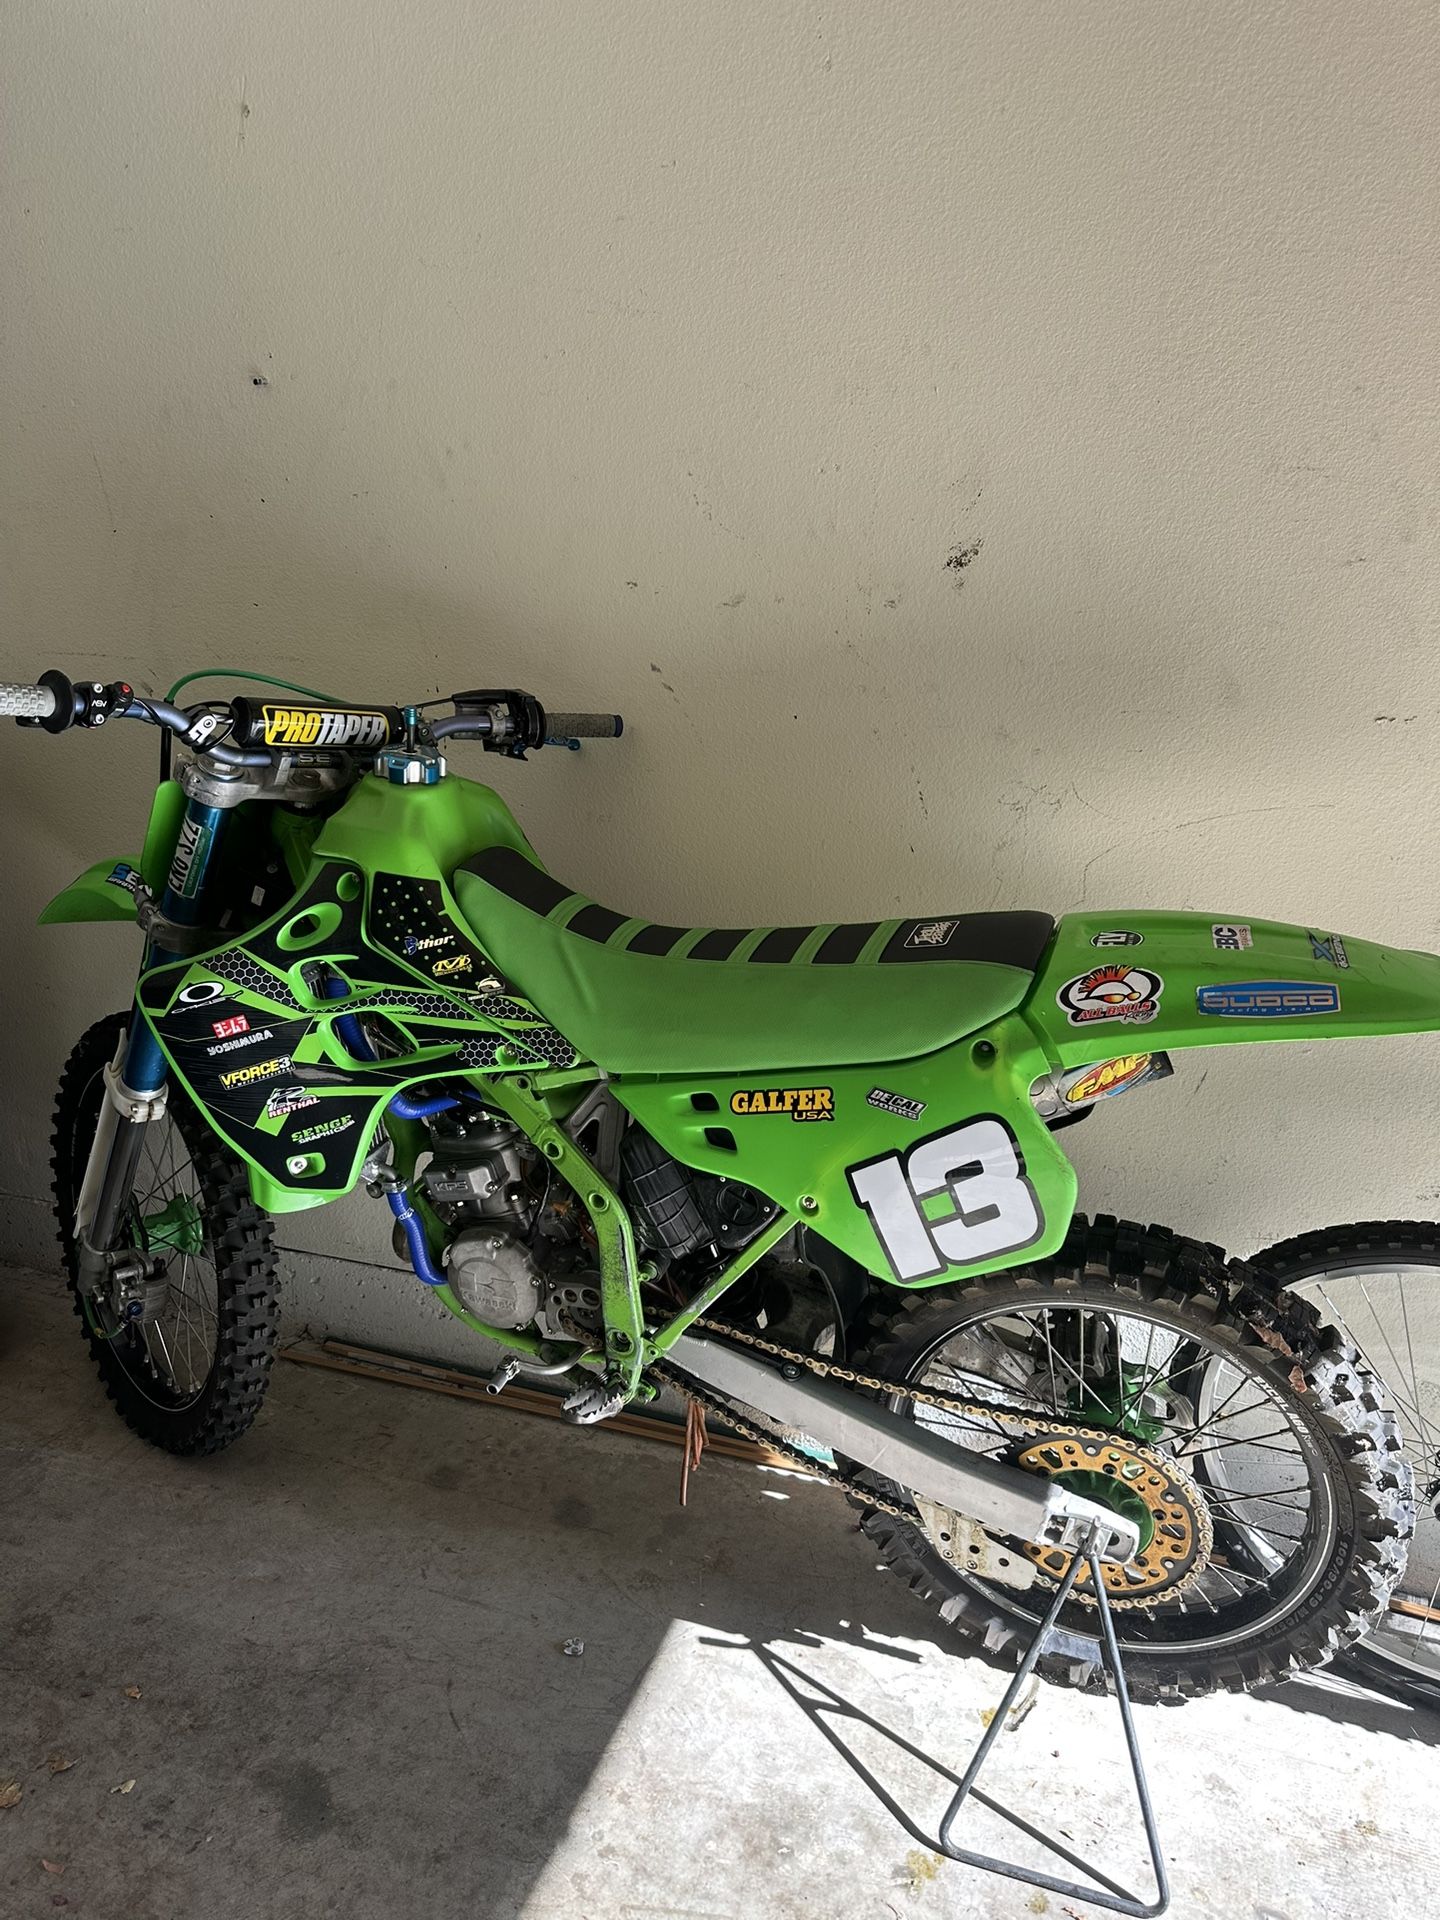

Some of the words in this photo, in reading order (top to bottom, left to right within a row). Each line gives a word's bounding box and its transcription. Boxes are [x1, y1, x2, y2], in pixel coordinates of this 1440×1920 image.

[266, 709, 386, 746] PROTAPER
[417, 935, 454, 951] thor
[1077, 1006, 1104, 1020] ALL
[1106, 1001, 1151, 1016] BALLS
[206, 1029, 274, 1056] YOSHIMURA
[221, 1056, 291, 1086] VFORCE3
[1071, 1053, 1150, 1102] FMF
[268, 1096, 320, 1118] RENTHAL
[731, 1088, 833, 1114] GALFER
[290, 1114, 353, 1142] SENGE
[794, 1111, 832, 1120] USA
[848, 1115, 1042, 1281] 13
[1252, 1375, 1290, 1411] EXCEL
